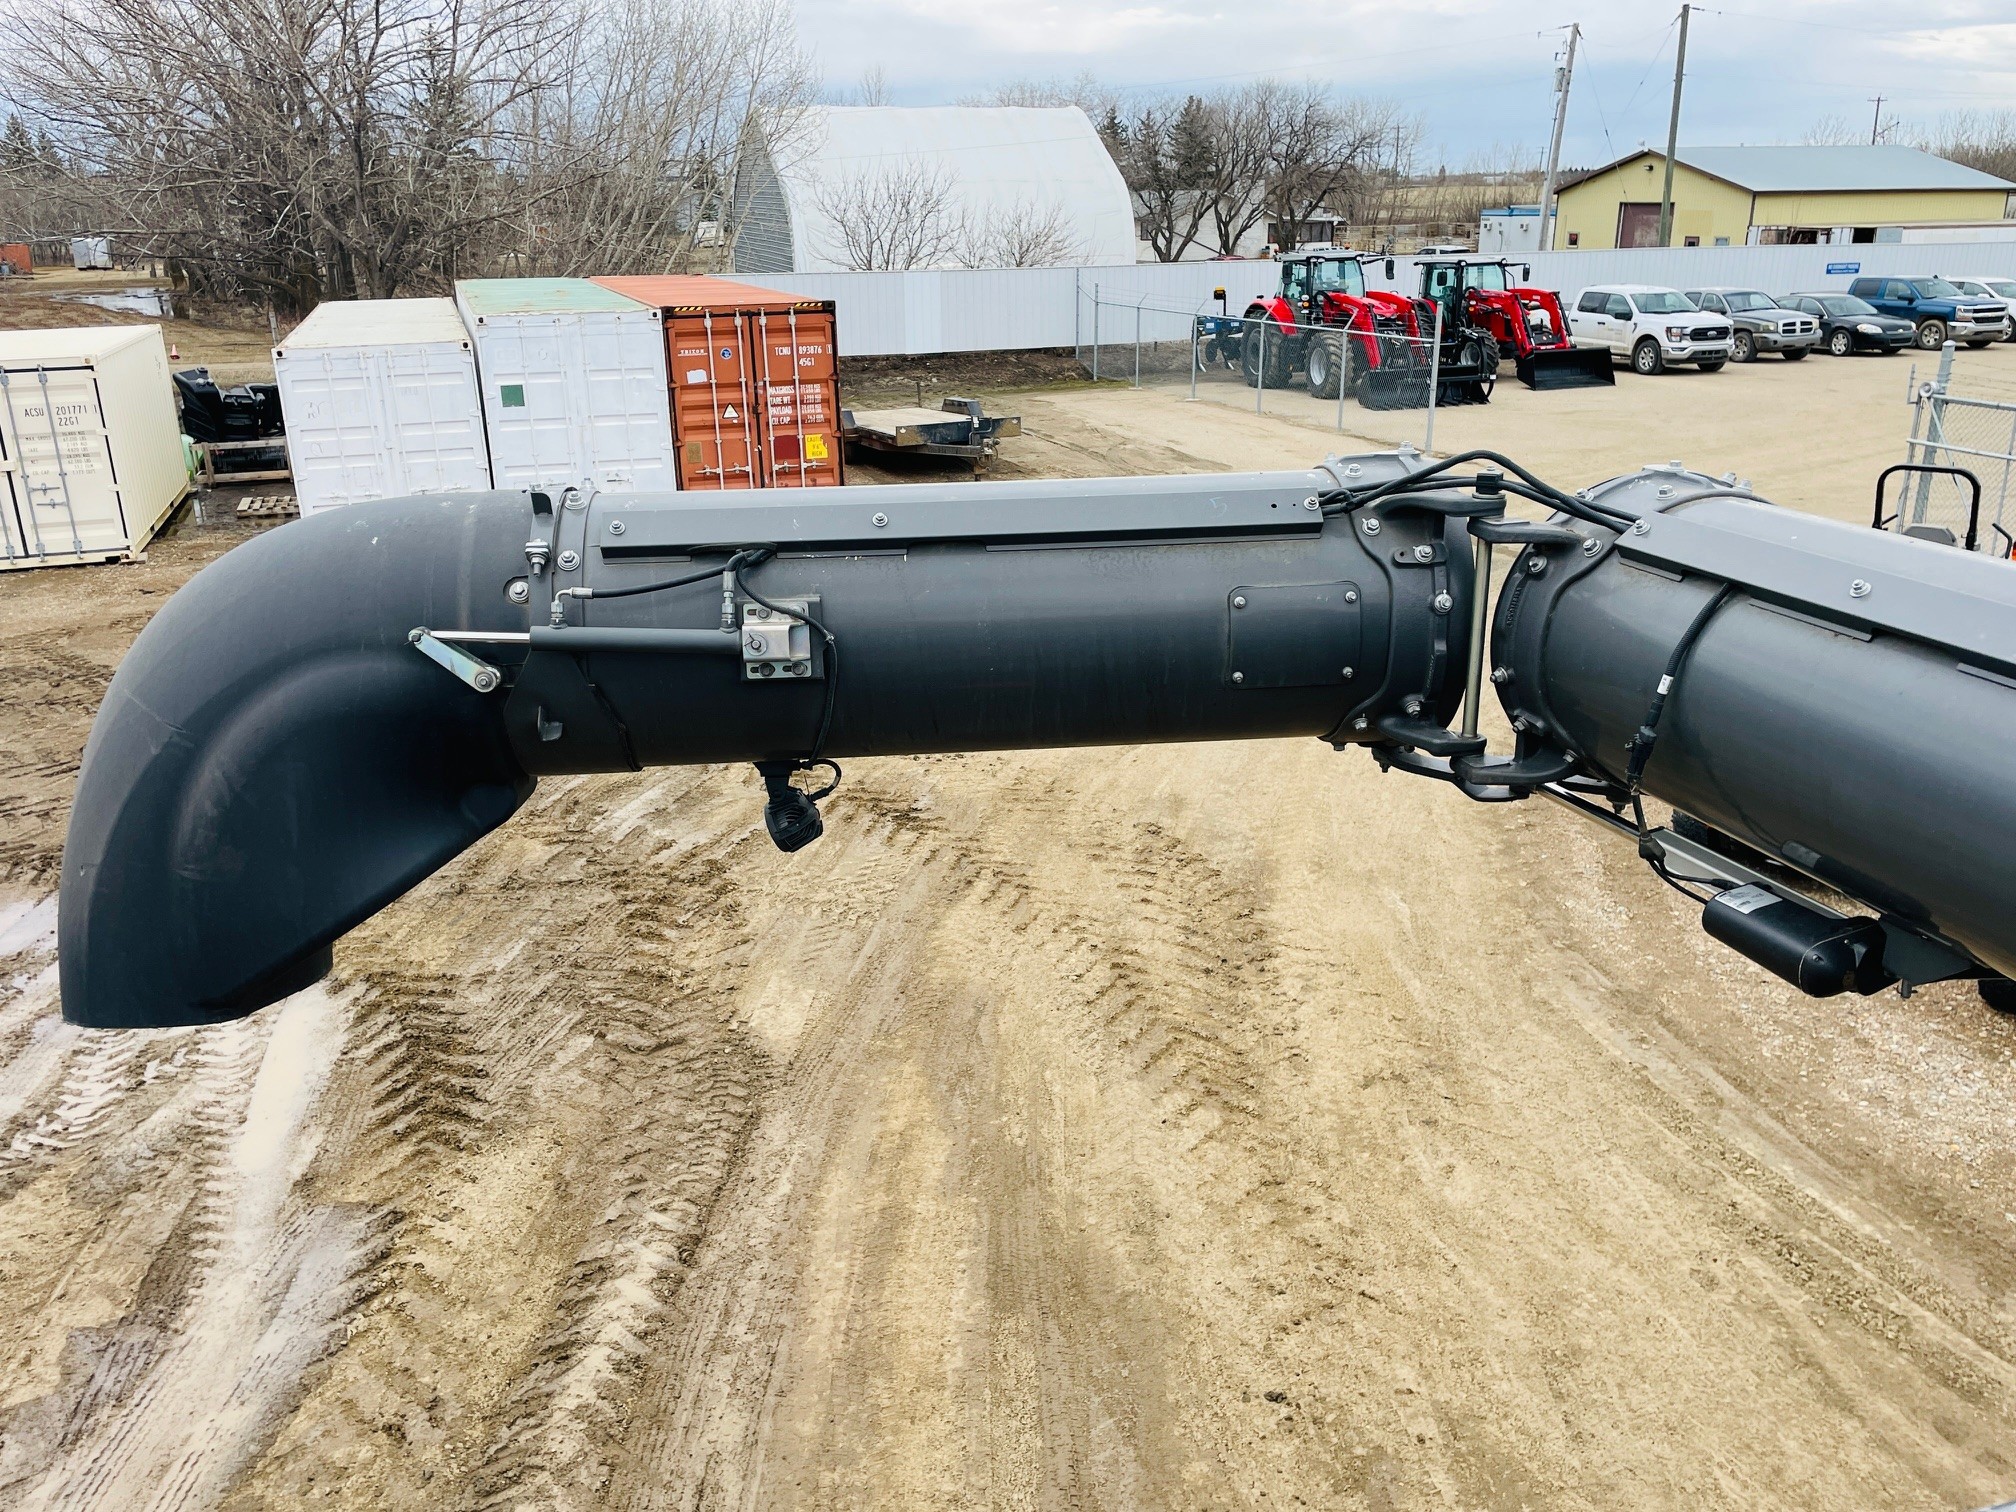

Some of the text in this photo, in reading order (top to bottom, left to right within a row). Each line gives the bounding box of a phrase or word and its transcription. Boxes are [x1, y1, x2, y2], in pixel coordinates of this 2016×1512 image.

[774, 346, 791, 356] TCNU
[799, 357, 815, 366] 45G1
[24, 408, 44, 418] ACSU
[56, 405, 87, 416] 201771
[58, 416, 79, 426] 22G1
